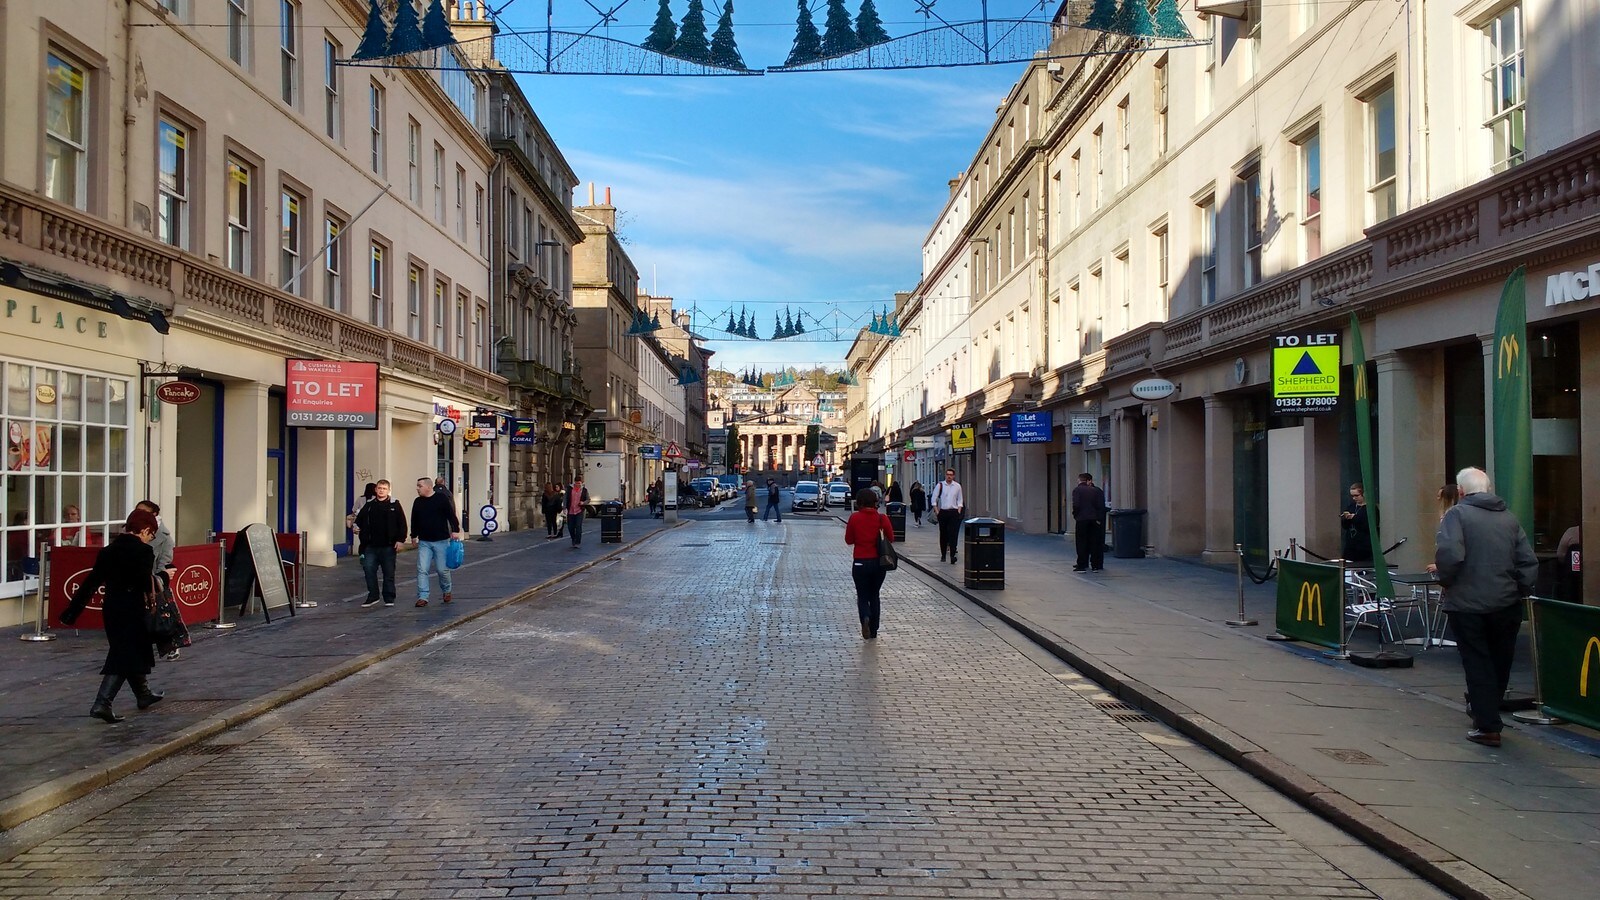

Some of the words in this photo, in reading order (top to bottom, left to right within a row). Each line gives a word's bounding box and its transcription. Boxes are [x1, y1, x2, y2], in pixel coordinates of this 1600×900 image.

[6, 299, 107, 338] PLACE
[1276, 335, 1300, 347] TO
[1306, 333, 1338, 346] LET
[1278, 376, 1336, 386] SHEPHERD
[163, 386, 195, 398] Pancake
[292, 380, 321, 396] TO
[327, 382, 364, 397] LET
[1276, 398, 1302, 407] 01382
[1305, 397, 1338, 406] 878005
[291, 412, 313, 421] 0131
[316, 413, 335, 422] 226
[337, 414, 364, 423] 8700
[1016, 430, 1038, 438] Ryden
[190, 570, 201, 579] The
[180, 579, 209, 594] Pancake
